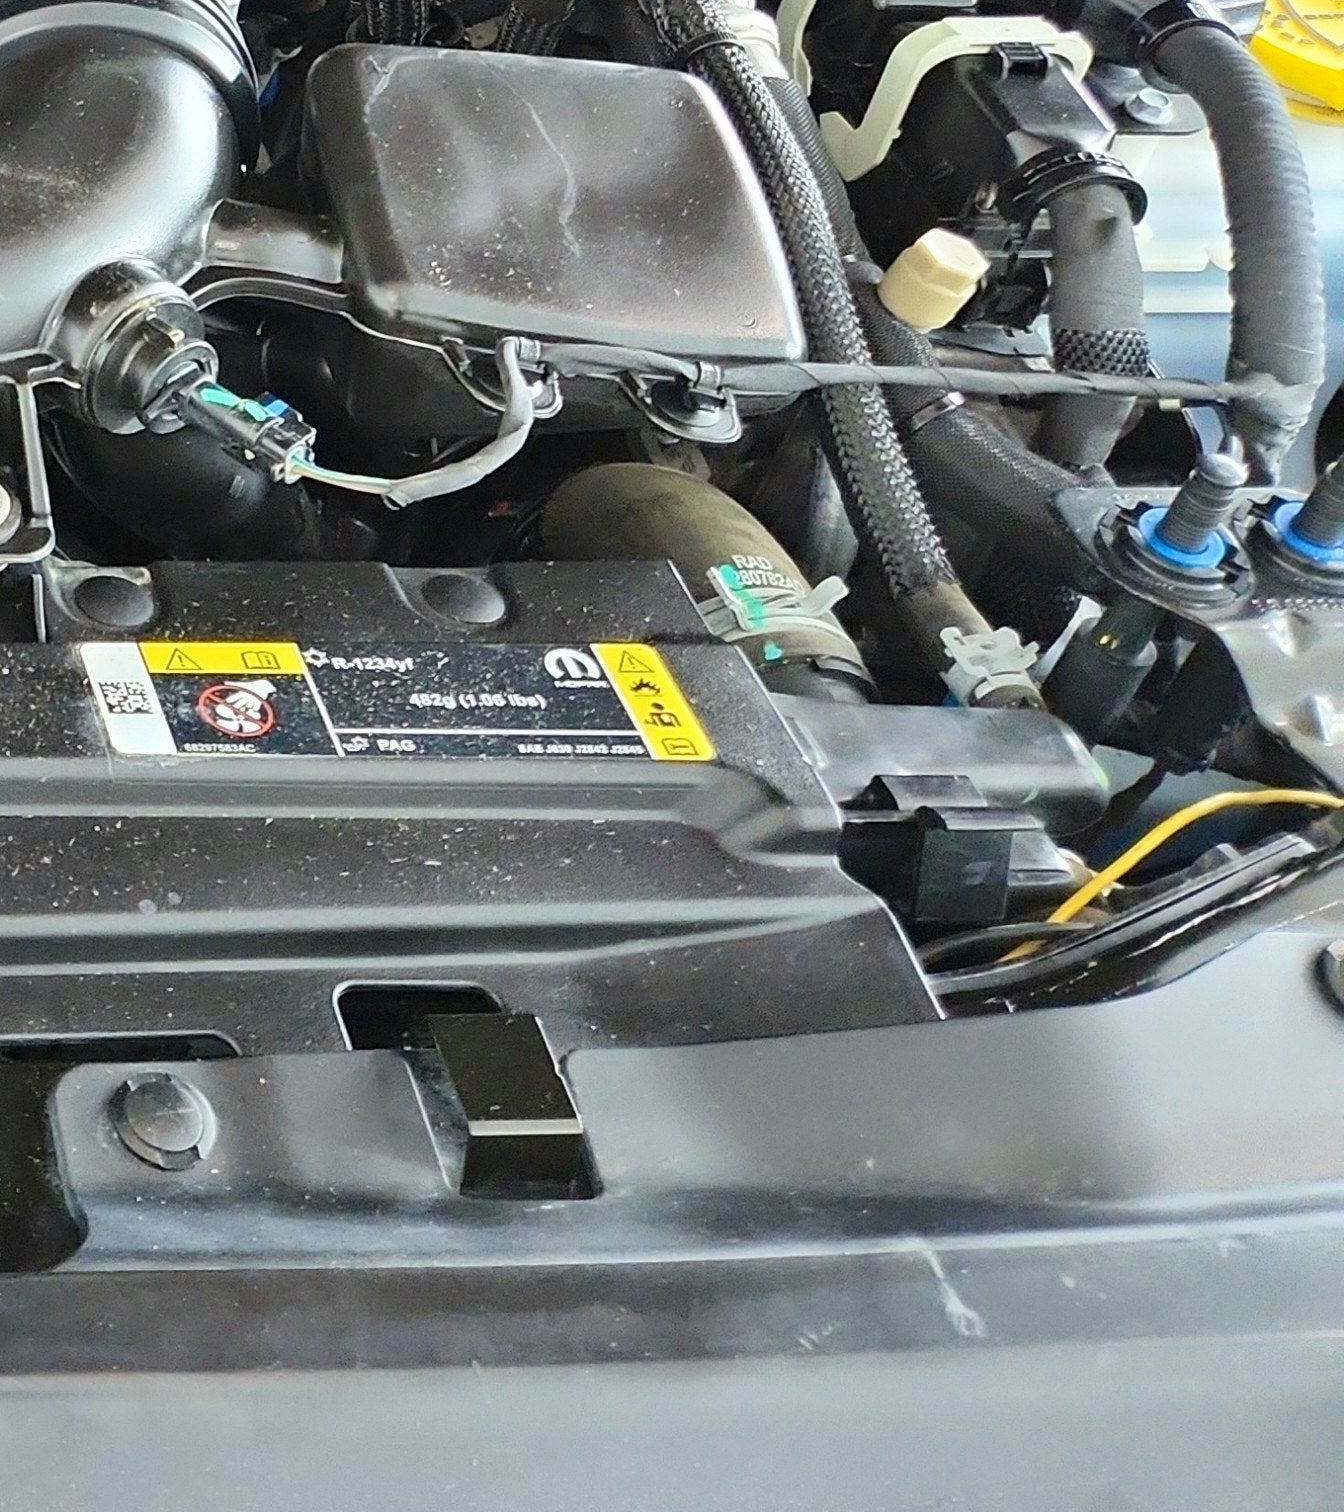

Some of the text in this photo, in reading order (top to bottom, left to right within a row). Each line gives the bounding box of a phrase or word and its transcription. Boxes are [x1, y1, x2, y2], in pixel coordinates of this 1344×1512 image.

[731, 554, 773, 571] RAD
[330, 656, 414, 673] R-1234yf
[409, 692, 548, 710] 482g (1.06 lbs)
[376, 738, 416, 753] PAG
[517, 743, 544, 754] SAE
